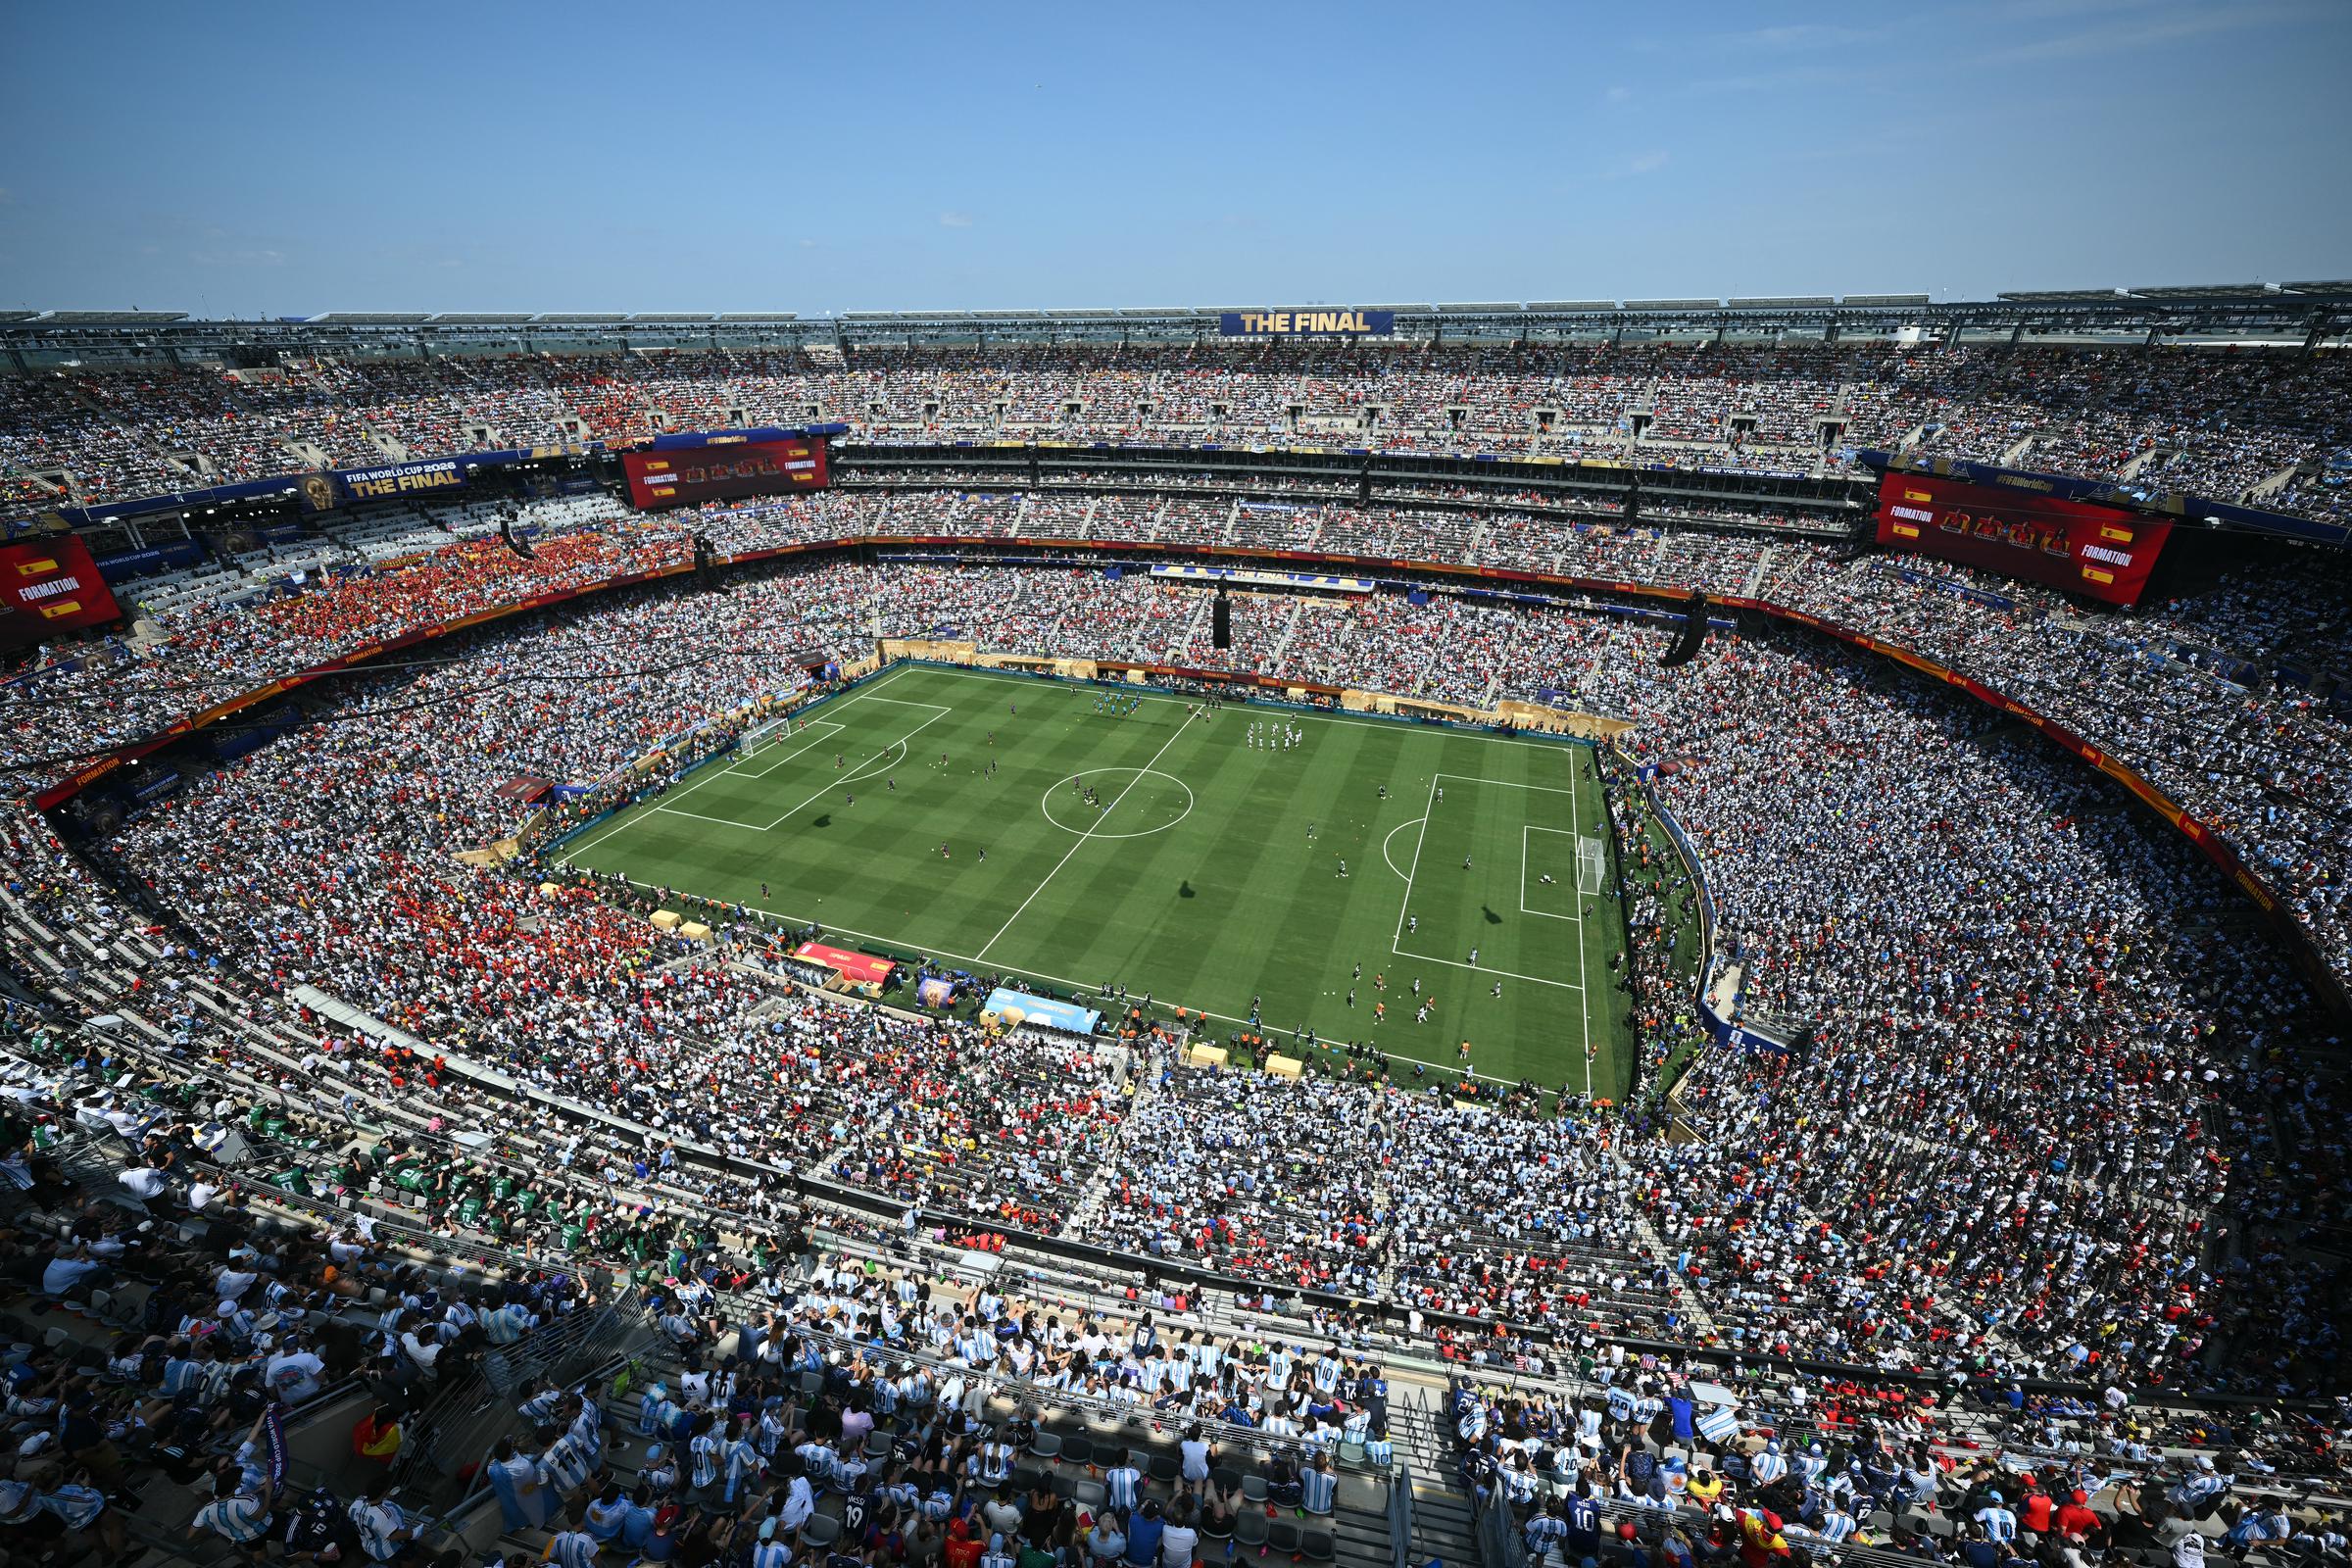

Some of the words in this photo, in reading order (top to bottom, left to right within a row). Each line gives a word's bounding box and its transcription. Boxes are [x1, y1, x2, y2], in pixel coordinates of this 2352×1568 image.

[1240, 313, 1290, 333] THE
[1294, 313, 1371, 332] FINAL
[346, 473, 367, 483] FIFA
[368, 468, 403, 480] WORLD
[405, 466, 422, 476] CUP
[424, 462, 456, 472] 2026
[785, 460, 815, 469] FORMATION
[349, 478, 397, 498] THE
[399, 470, 461, 492] FINAL
[644, 473, 678, 485] FORMATION
[1995, 473, 2053, 492] #FIFAWorldCup
[1890, 505, 1933, 522] FORMATION
[2082, 545, 2132, 567] FORMATION
[1538, 575, 1573, 584] FORMATION
[19, 576, 79, 602] FORMATION
[1785, 612, 1819, 625] FORMATION
[346, 646, 382, 664] FORMATION
[2005, 703, 2044, 727] FORMATION
[76, 758, 121, 787] FORMATION
[557, 831, 574, 843] WORLD
[574, 825, 585, 834] CUP
[2234, 870, 2274, 911] FORMATION
[1137, 1330, 1150, 1347] 10
[1273, 1362, 1283, 1376] 10
[1321, 1365, 1333, 1381] 10
[876, 1390, 887, 1406] 10
[1614, 1399, 1628, 1410] 10
[1644, 1408, 1656, 1417] 10
[270, 1431, 280, 1449] WORLD
[559, 1451, 576, 1472] 11
[1375, 1452, 1389, 1464] 10
[1565, 1458, 1577, 1470] 10
[848, 1495, 865, 1506] MESSI
[846, 1505, 863, 1530] 19
[1575, 1508, 1594, 1532] 10
[1998, 1520, 2013, 1539] 10
